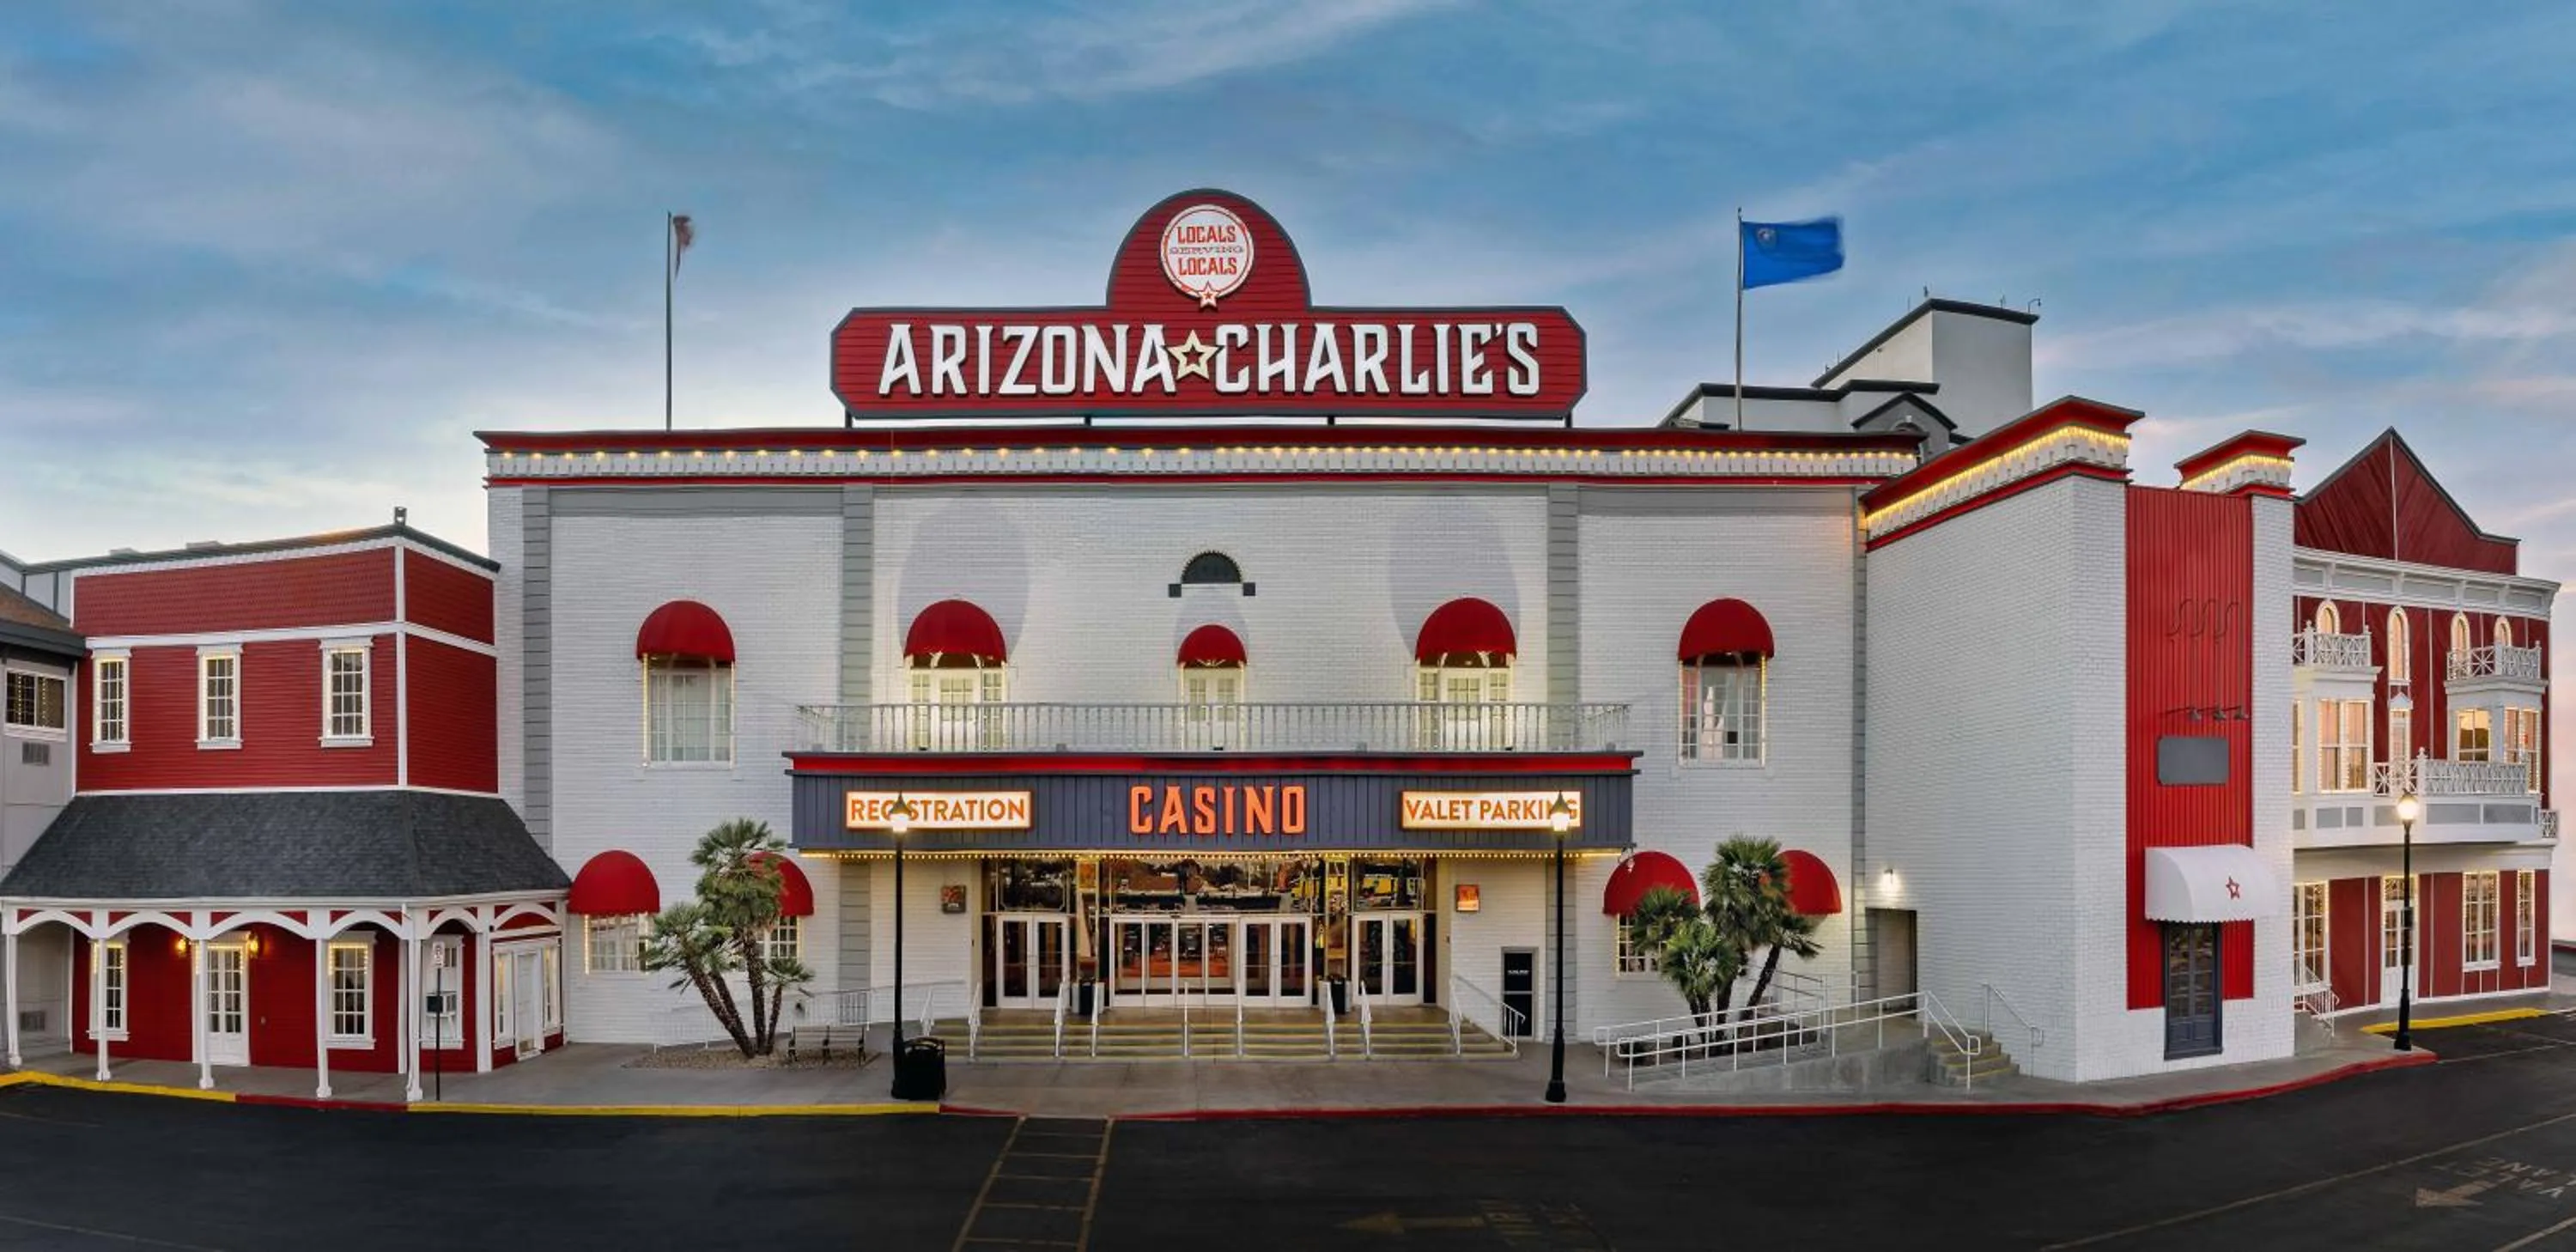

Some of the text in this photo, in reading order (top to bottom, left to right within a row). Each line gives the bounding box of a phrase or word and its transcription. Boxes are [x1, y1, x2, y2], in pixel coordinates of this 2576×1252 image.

[1177, 225, 1236, 243] LOCALS
[1178, 257, 1237, 275] LOCALS
[878, 322, 1540, 396] ARIZONA CHARLIE'S
[851, 799, 1025, 822] REGSTRATION
[1130, 786, 1305, 835] CASINO
[1405, 799, 1473, 820] VALET
